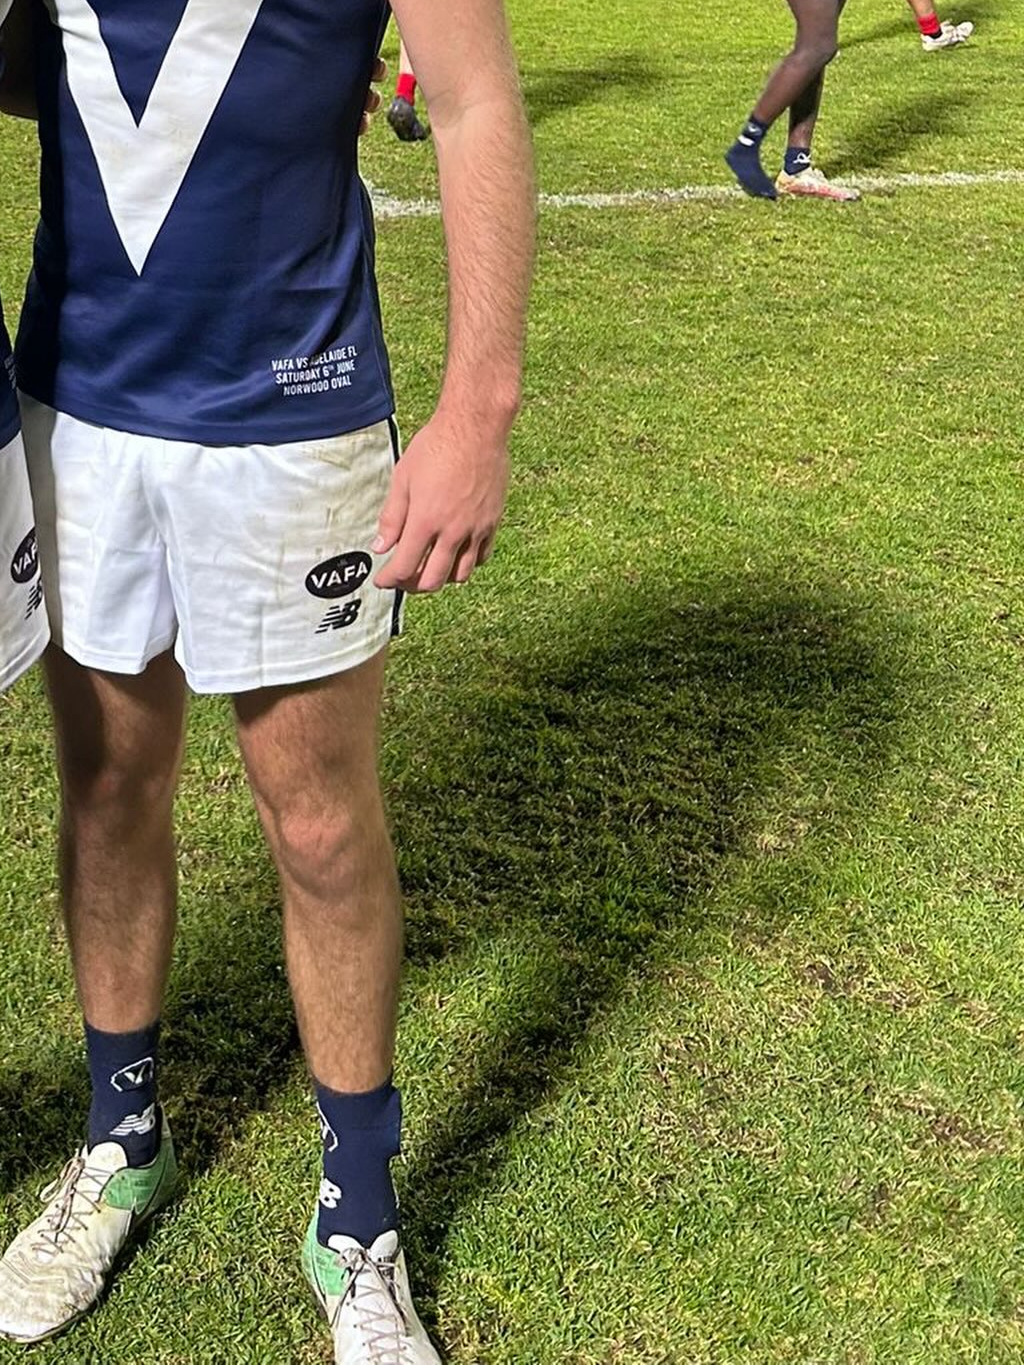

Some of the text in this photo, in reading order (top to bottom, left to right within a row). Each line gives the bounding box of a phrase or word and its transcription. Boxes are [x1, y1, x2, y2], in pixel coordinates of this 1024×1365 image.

[271, 360, 294, 371] VAFA
[296, 357, 308, 369] VS
[348, 346, 357, 356] FL
[276, 369, 320, 384] SATURDAY
[336, 360, 355, 374] JUNE
[283, 376, 352, 396] NORWOOD OVAL
[13, 541, 37, 574] VAF
[311, 561, 368, 589] VAFA
